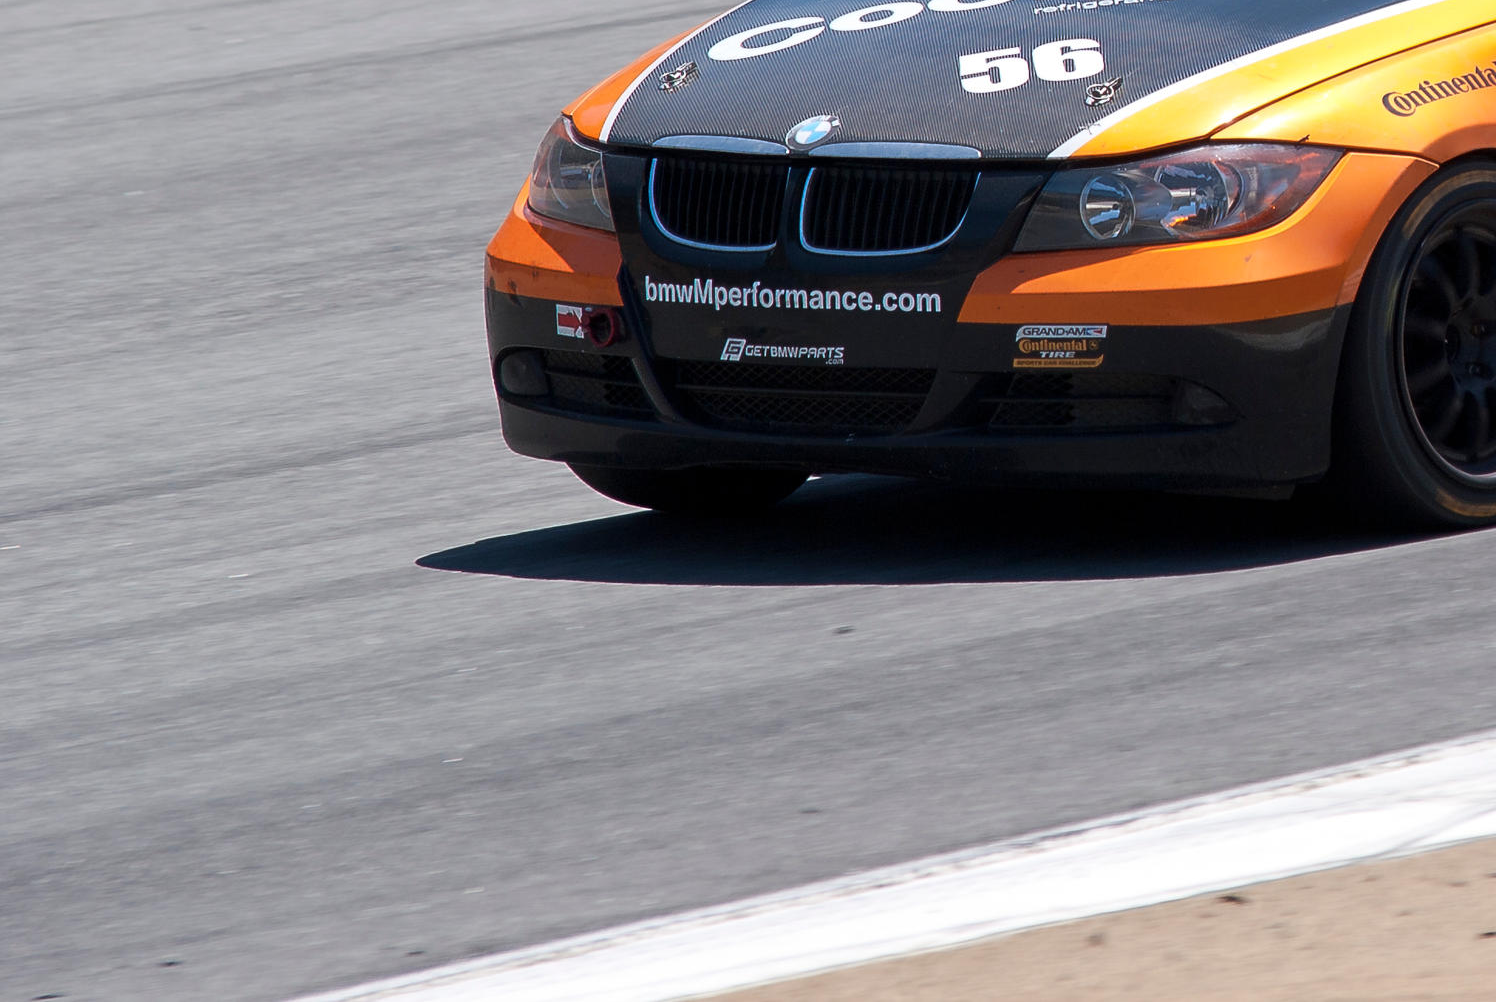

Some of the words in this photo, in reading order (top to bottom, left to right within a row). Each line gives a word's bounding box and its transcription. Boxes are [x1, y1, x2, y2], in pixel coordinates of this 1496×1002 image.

[958, 38, 1106, 94] 56
[645, 275, 942, 312] bmwMperformance.com
[745, 345, 844, 359] GETBMWPARTS
[1019, 339, 1087, 353] Continental
